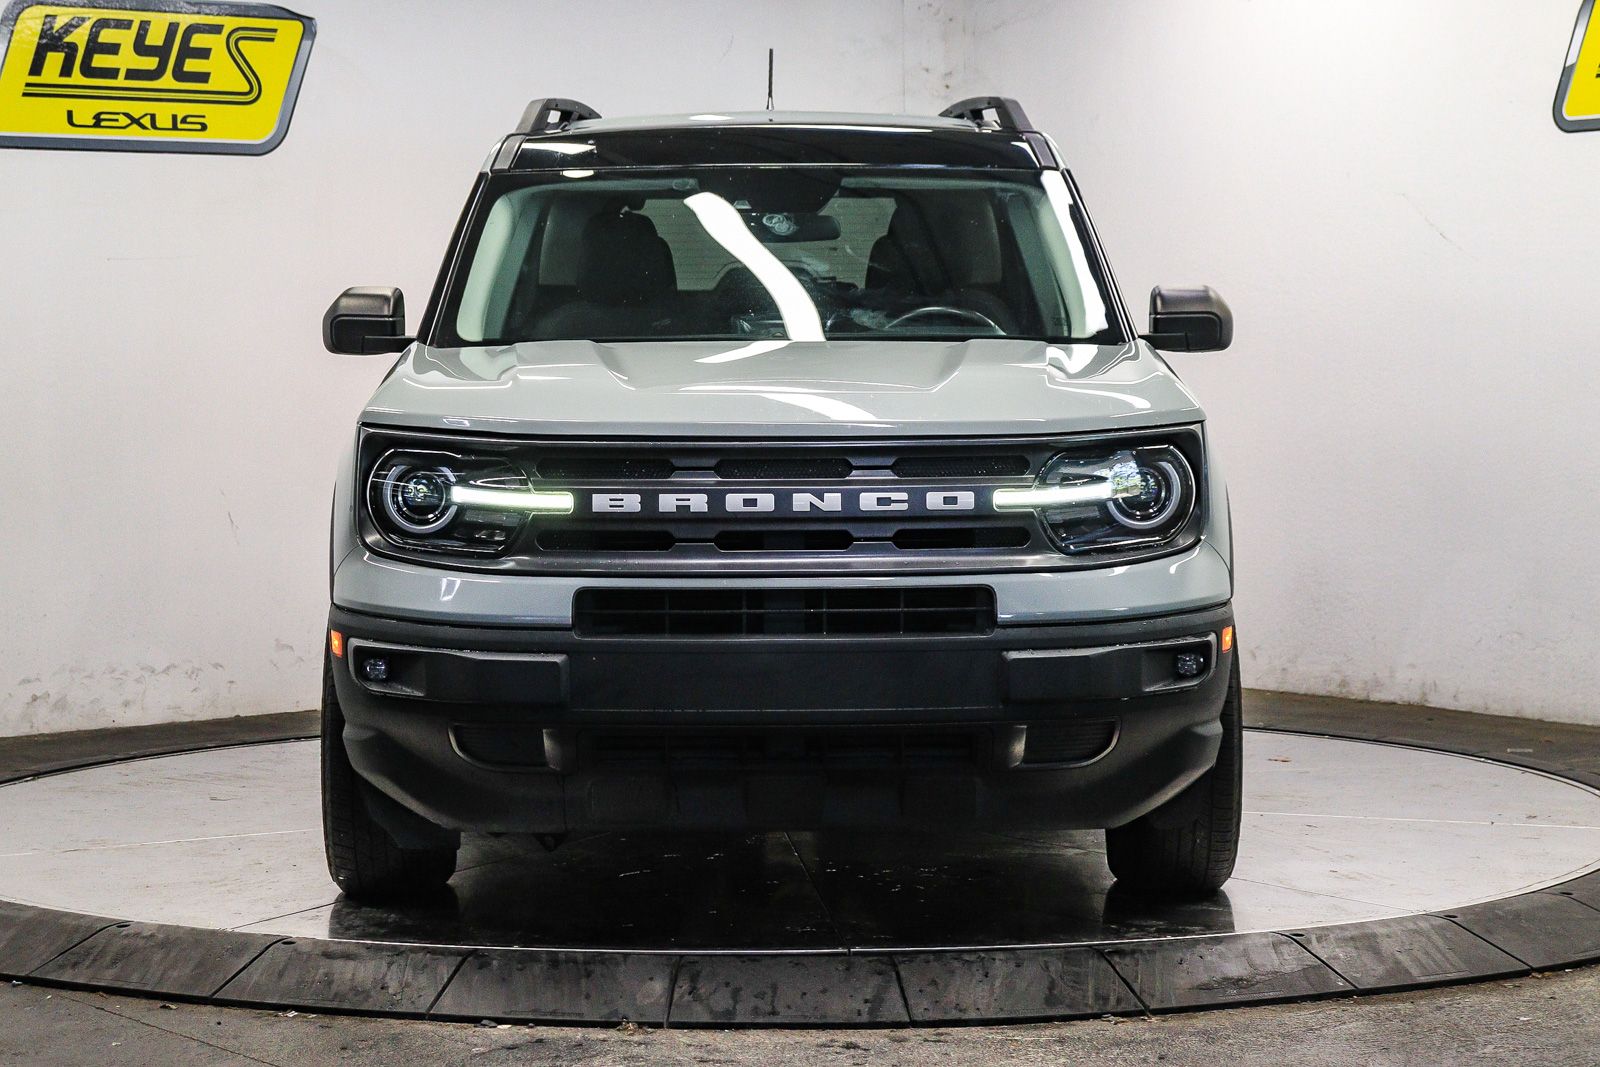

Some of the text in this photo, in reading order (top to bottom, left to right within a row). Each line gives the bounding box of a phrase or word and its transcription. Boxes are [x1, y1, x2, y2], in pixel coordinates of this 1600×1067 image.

[22, 14, 278, 106] KEYES
[66, 109, 208, 132] LEXUS
[591, 491, 975, 513] BRONCO
